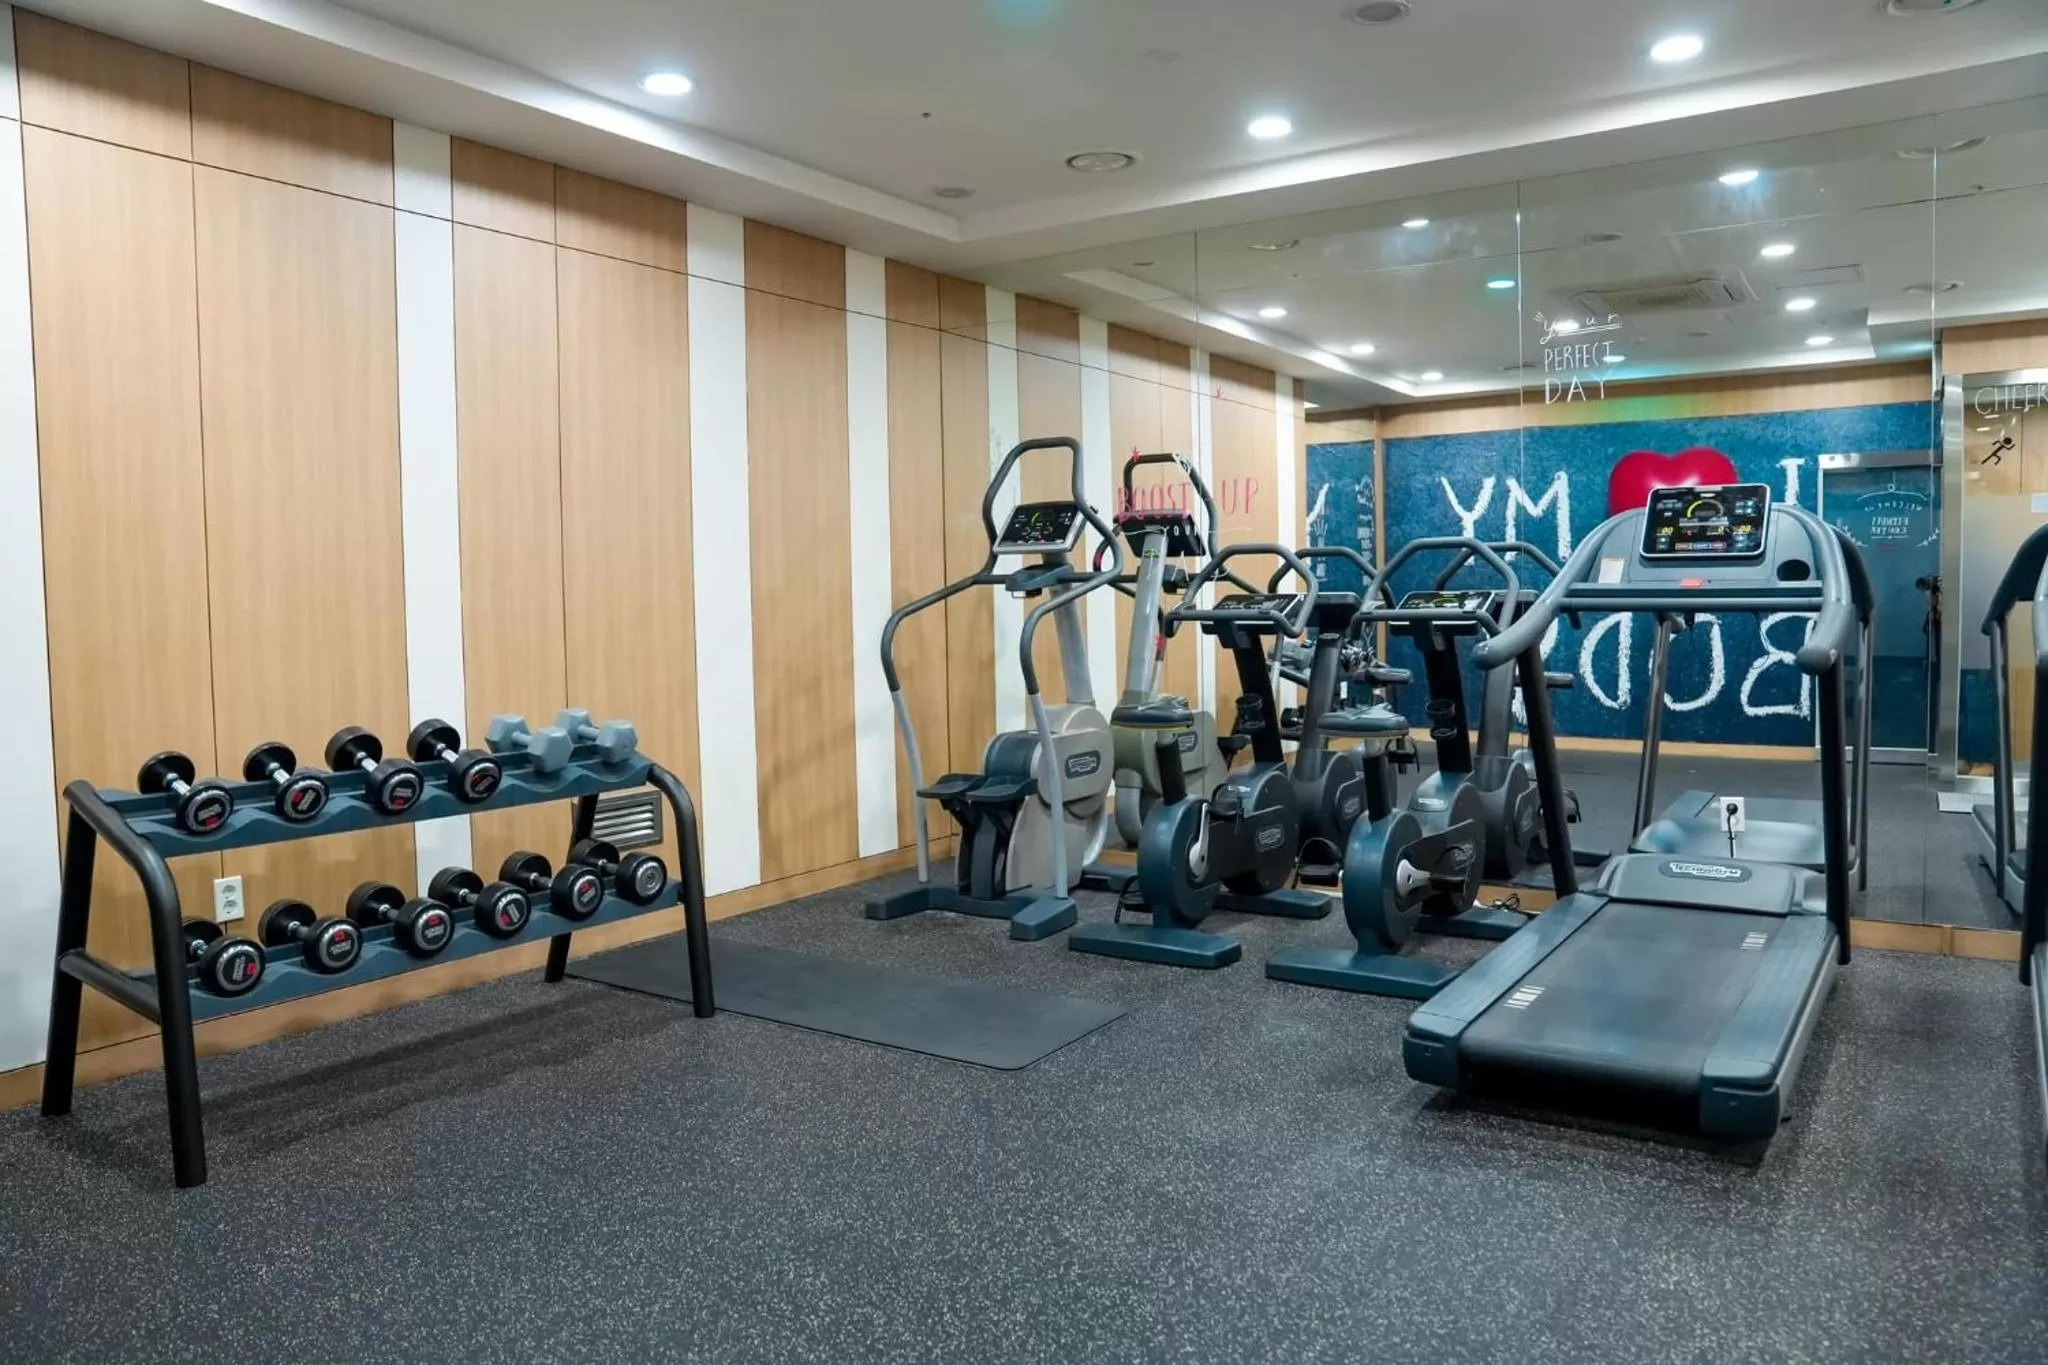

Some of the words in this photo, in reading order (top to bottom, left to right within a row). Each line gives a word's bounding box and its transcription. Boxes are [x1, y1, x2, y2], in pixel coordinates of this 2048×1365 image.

[1540, 313, 1619, 344] yur
[1545, 341, 1614, 372] PERFECT
[1545, 370, 1613, 404] DAY
[1117, 482, 1191, 520] BOOST
[1221, 476, 1259, 515] UP
